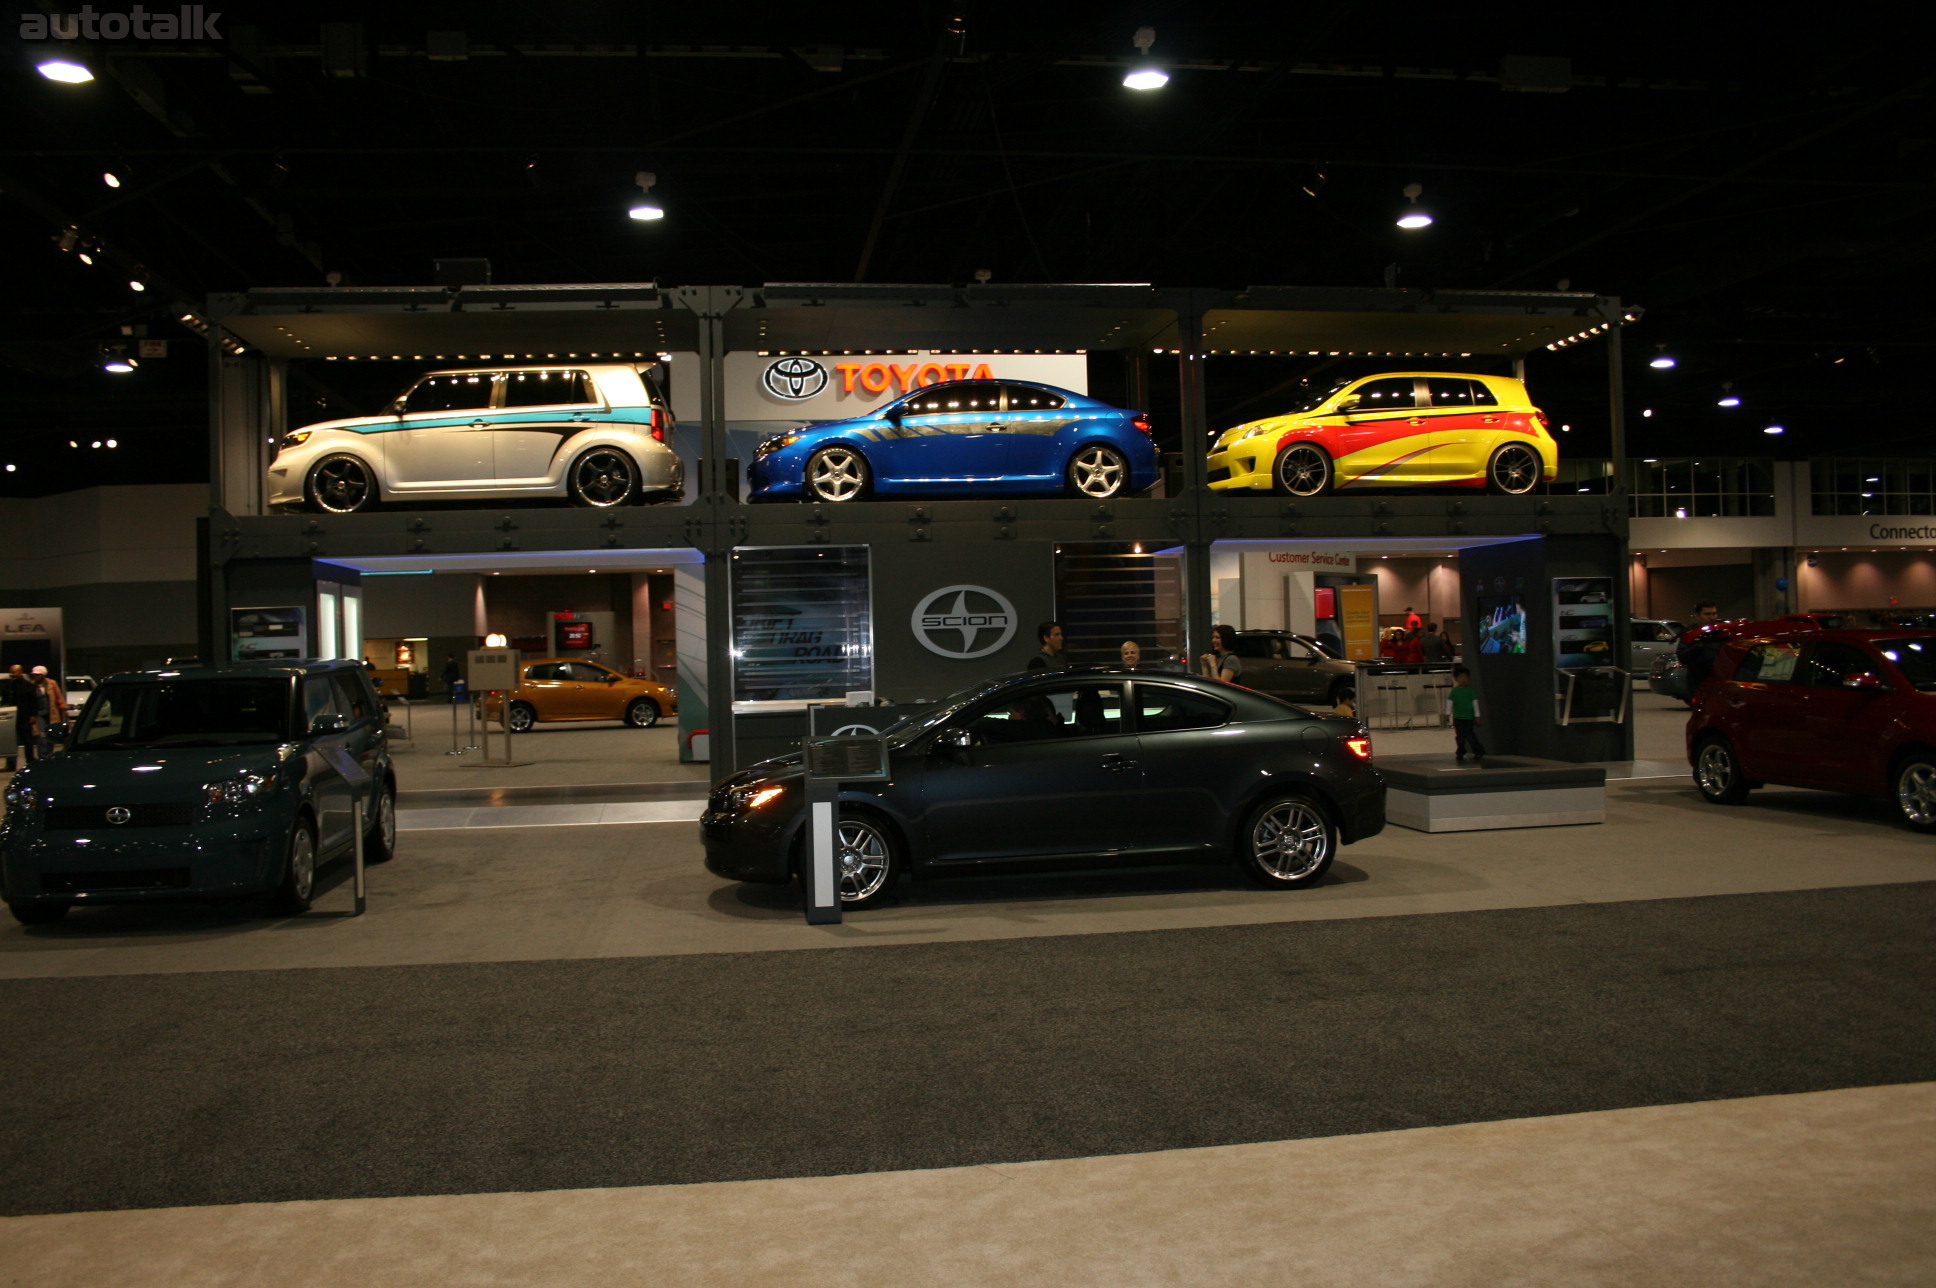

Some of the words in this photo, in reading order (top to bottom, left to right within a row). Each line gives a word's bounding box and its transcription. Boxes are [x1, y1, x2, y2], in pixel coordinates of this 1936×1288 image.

[836, 363, 994, 392] TOYOTA
[1268, 552, 1310, 563] Customer
[1311, 552, 1334, 565] Service
[5, 624, 46, 632] LFA
